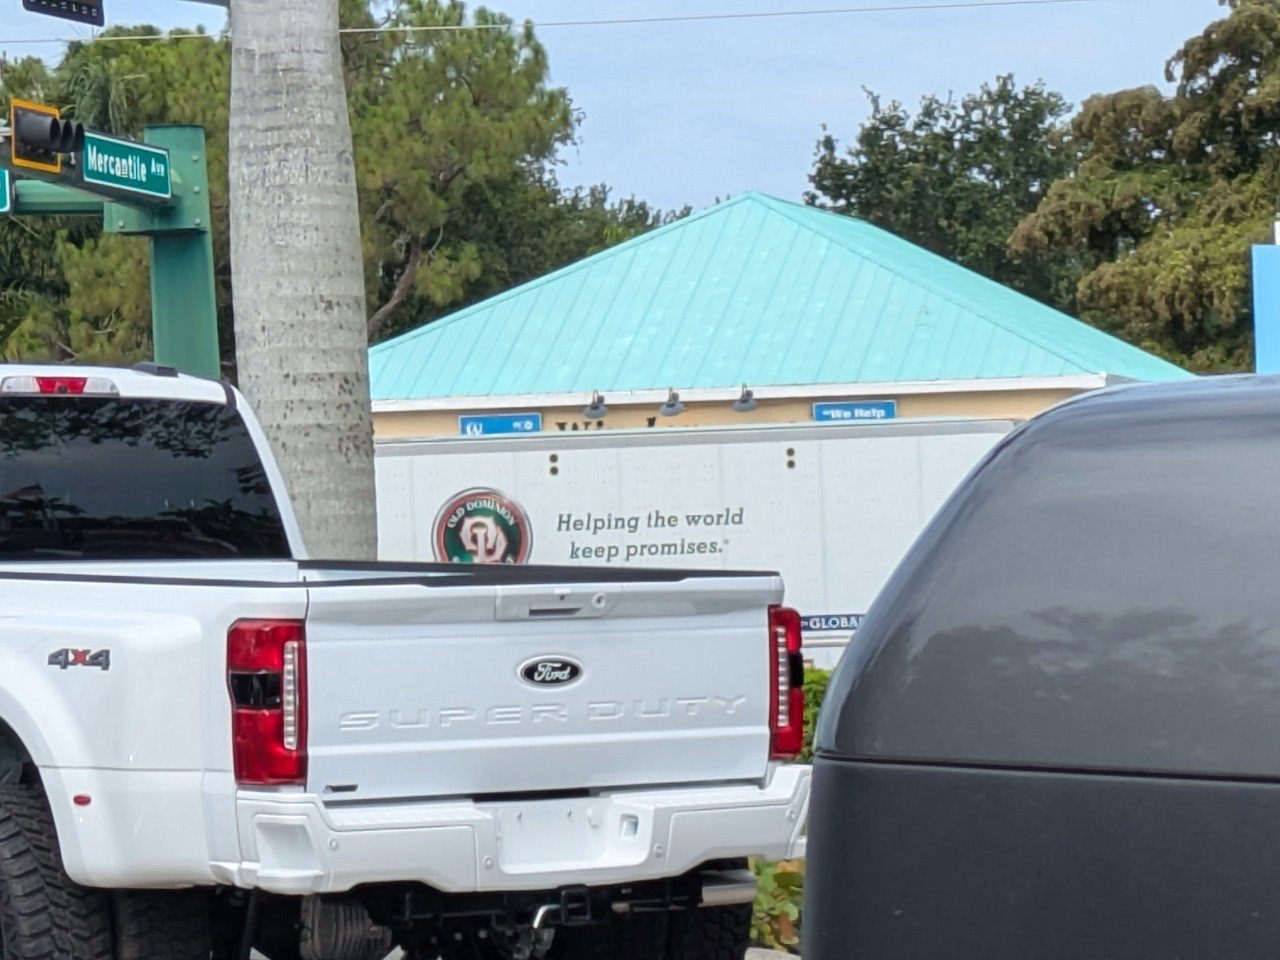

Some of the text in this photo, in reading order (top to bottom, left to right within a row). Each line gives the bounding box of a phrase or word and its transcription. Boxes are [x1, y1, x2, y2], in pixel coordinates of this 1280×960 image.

[87, 143, 165, 183] Mercantile Ave
[556, 507, 744, 536] Helping the world
[569, 541, 619, 563] keep
[533, 662, 571, 682] Ford
[339, 695, 747, 731] SUPER DUTY
